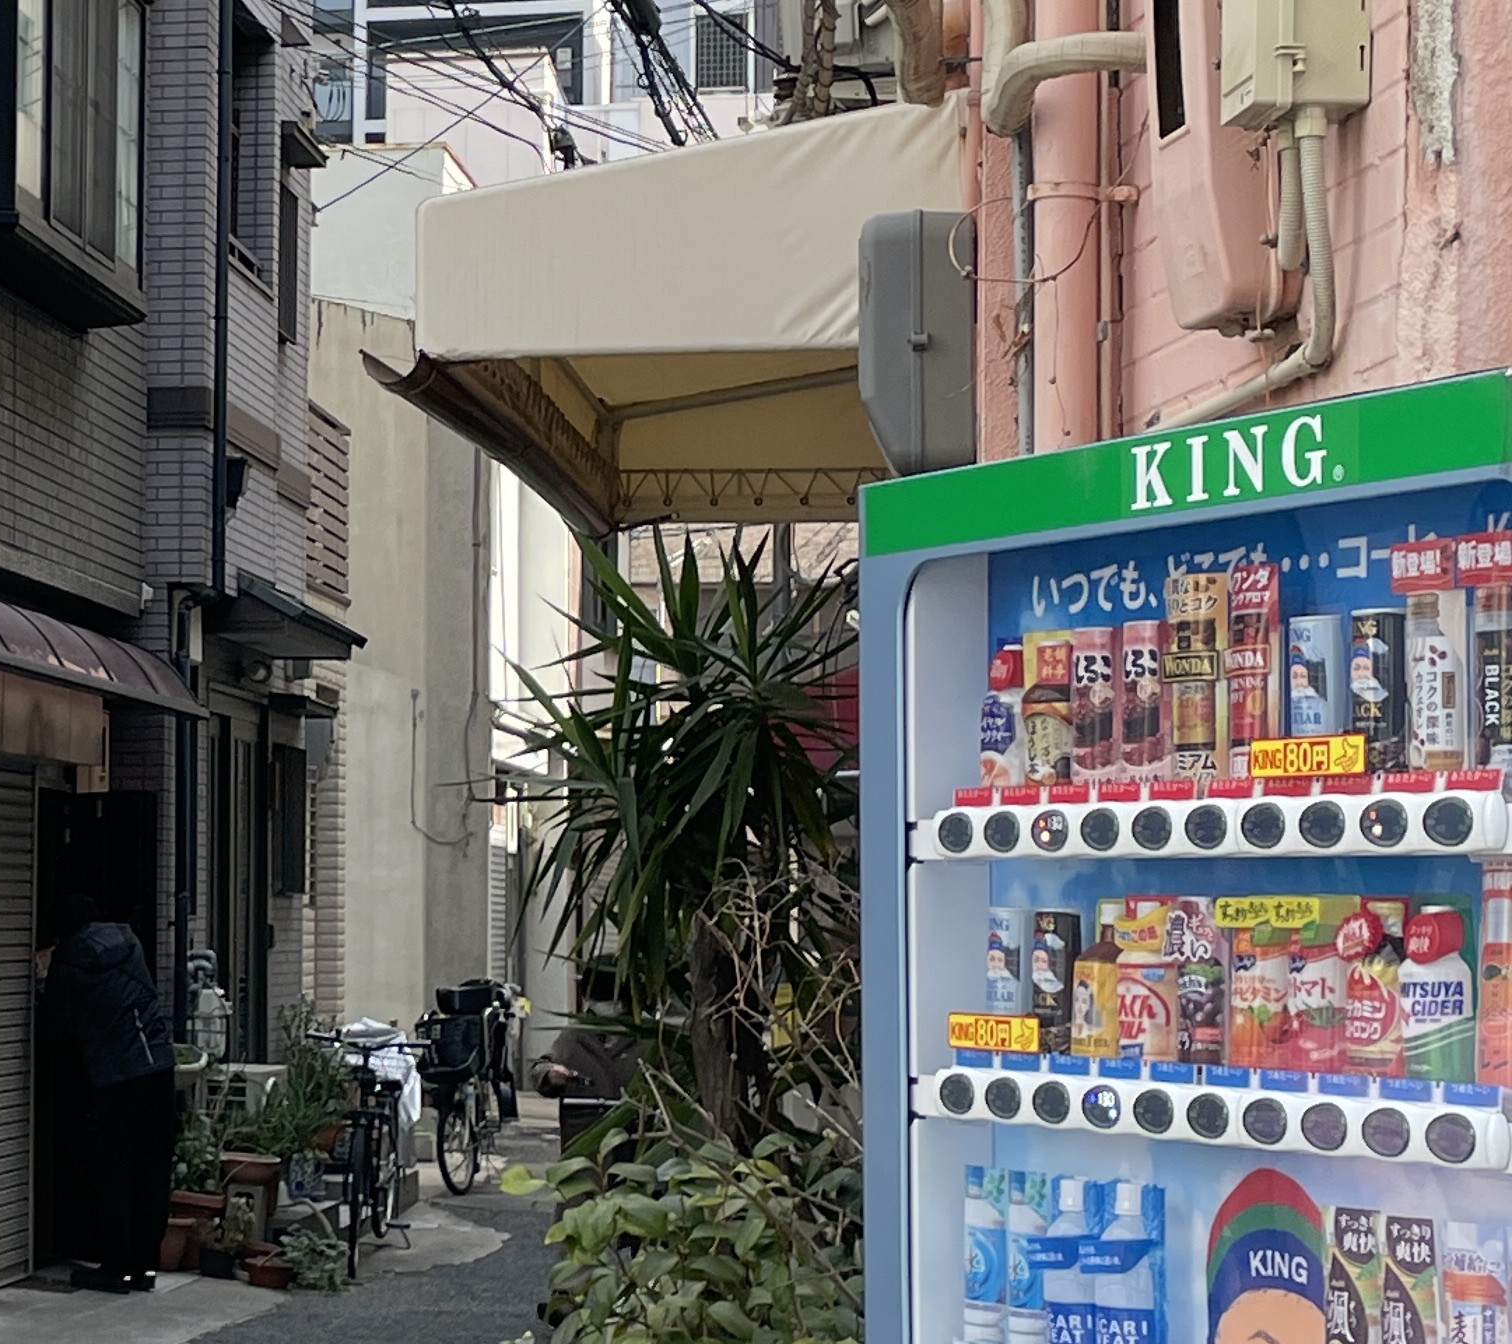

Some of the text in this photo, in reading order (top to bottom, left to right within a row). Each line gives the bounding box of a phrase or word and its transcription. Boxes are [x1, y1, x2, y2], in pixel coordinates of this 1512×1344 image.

[1130, 414, 1326, 512] KING
[1164, 657, 1212, 676] WONDA
[1252, 742, 1330, 772] KING 80円
[1411, 998, 1464, 1017] CIDER
[950, 1019, 1011, 1047] KING 80円
[1395, 1241, 1432, 1263] 爽快
[1248, 1250, 1309, 1285] KING
[1096, 1316, 1148, 1336] CARI
